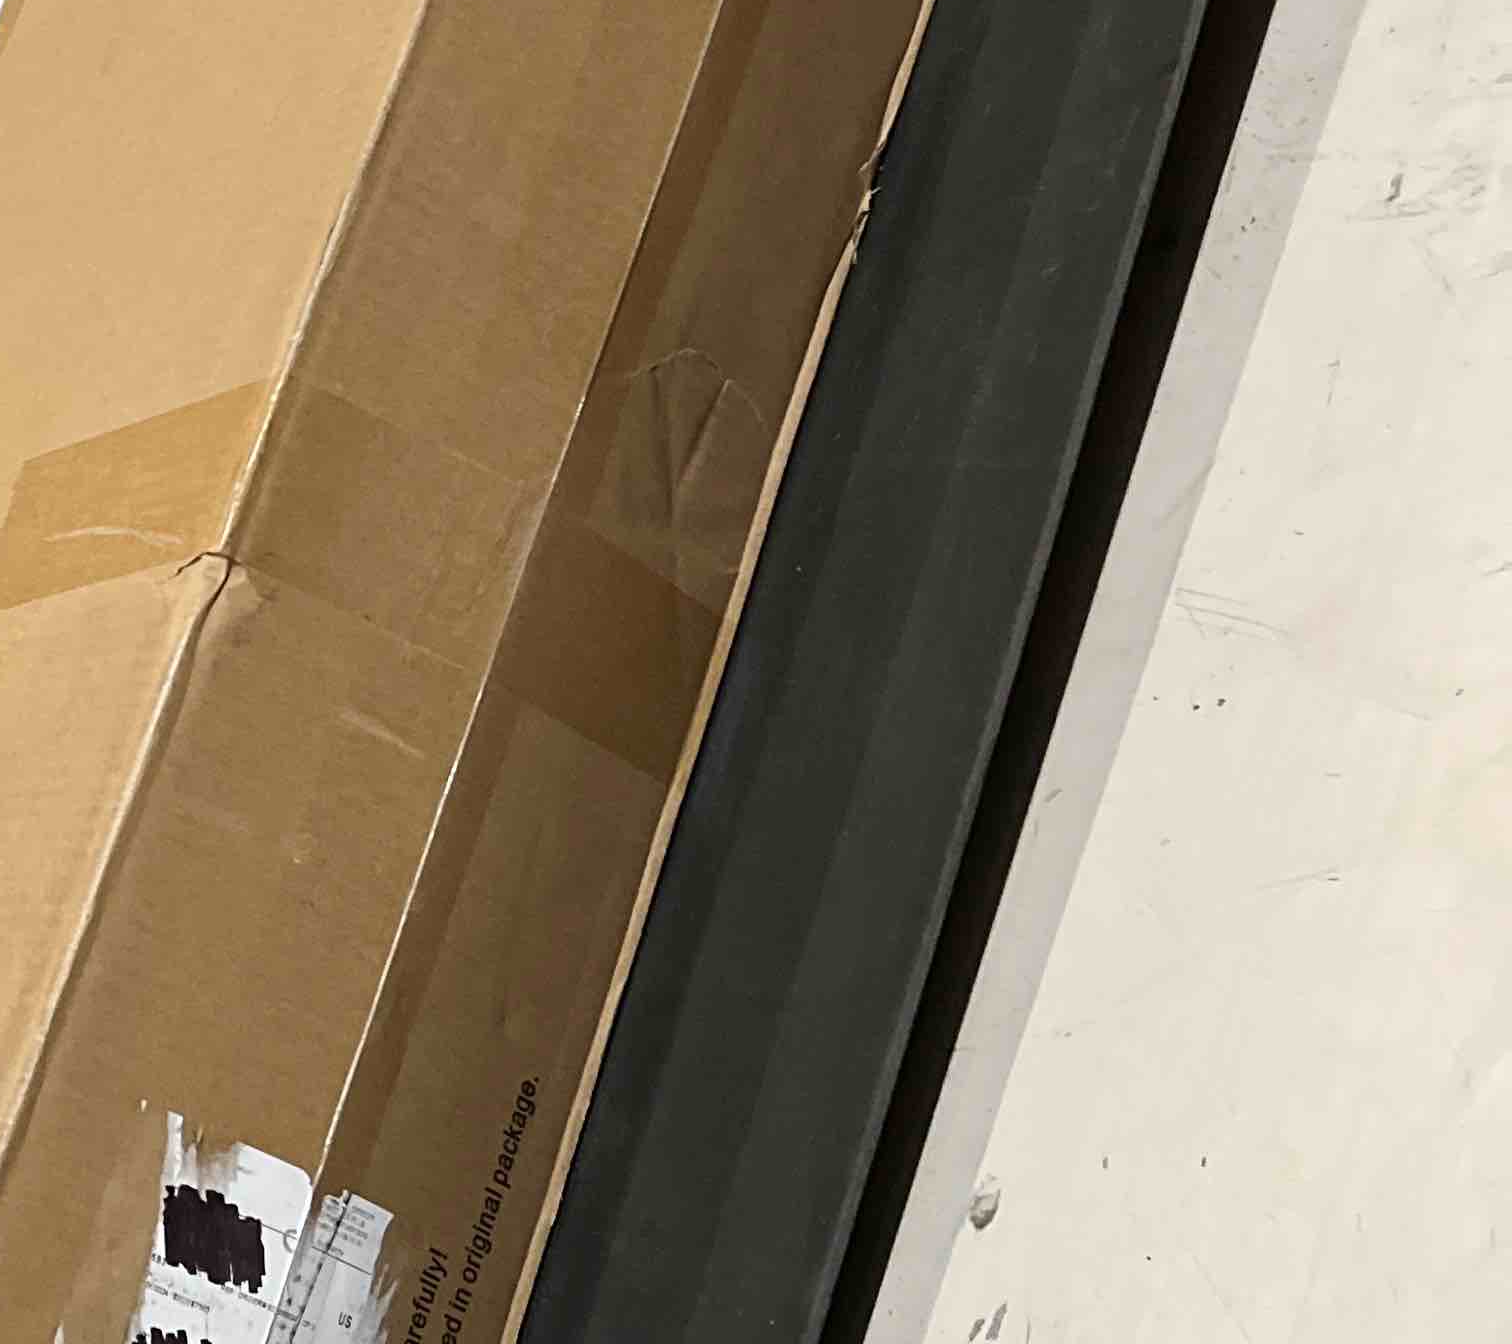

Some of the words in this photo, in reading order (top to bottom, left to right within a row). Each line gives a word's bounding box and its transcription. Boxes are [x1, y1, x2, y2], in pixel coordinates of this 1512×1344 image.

[448, 1287, 473, 1313] in
[462, 1186, 503, 1284] original
[492, 1076, 540, 1190] package.
[338, 1311, 353, 1329] US
